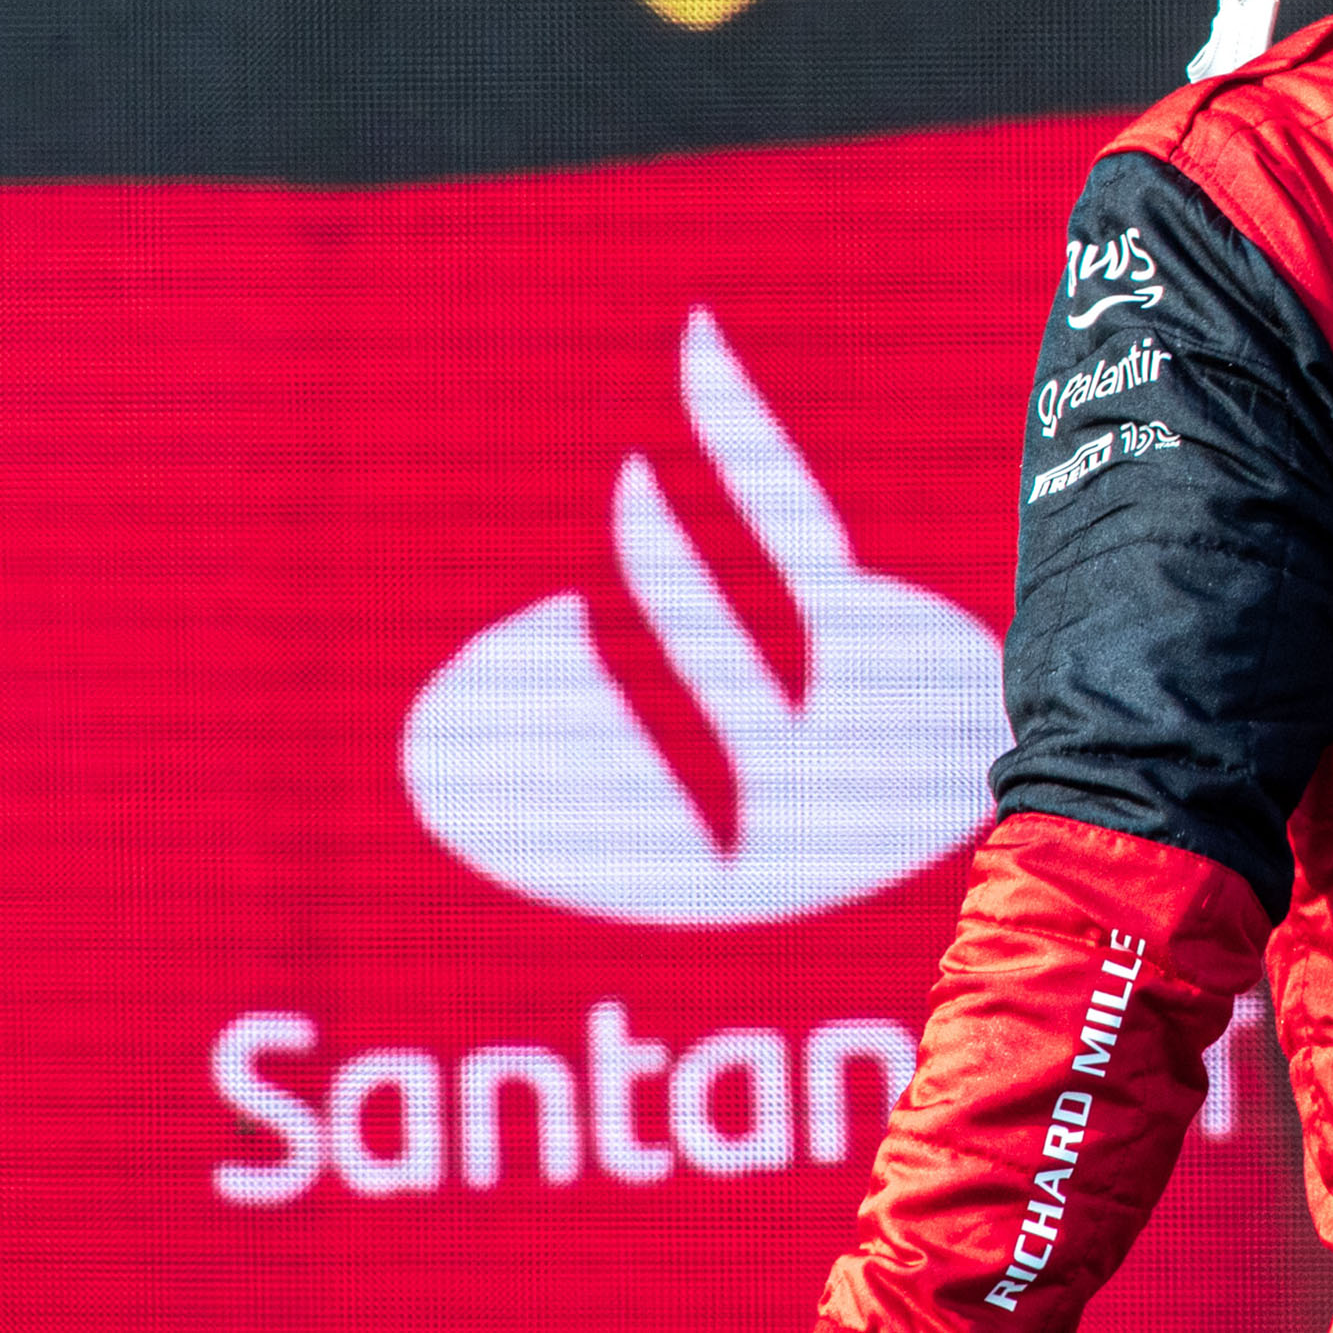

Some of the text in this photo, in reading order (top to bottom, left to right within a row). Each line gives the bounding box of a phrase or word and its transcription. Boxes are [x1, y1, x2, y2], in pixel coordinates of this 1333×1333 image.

[1057, 338, 1172, 419] Palantir
[1027, 432, 1114, 505] PIRELLI
[208, 993, 1268, 1211] Santanr
[984, 928, 1147, 1313] RICHARD MILLE
